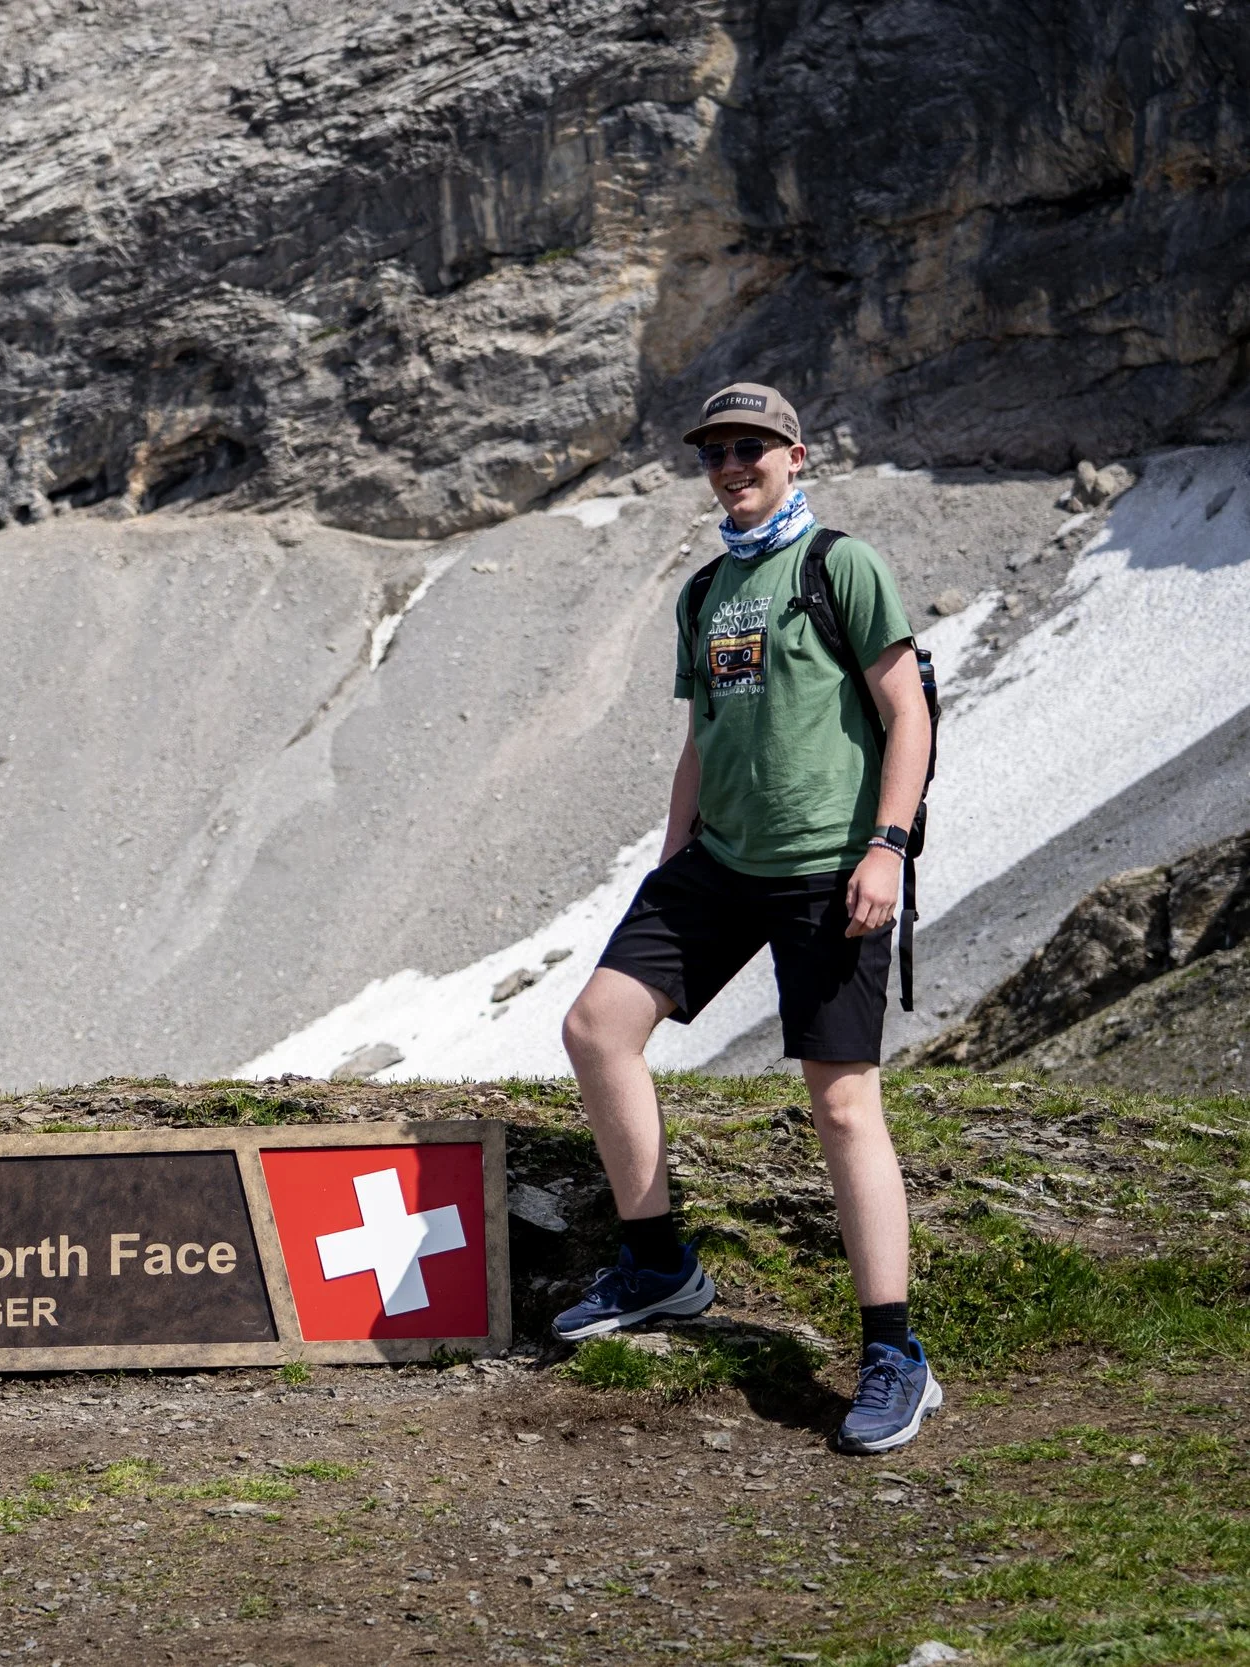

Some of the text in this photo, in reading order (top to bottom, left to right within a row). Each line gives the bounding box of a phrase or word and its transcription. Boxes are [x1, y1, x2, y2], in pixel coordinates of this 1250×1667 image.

[710, 396, 763, 411] AMSTERDAM
[712, 596, 772, 622] SCOTCH
[708, 612, 766, 638] AND SODA
[110, 1232, 238, 1276] Face
